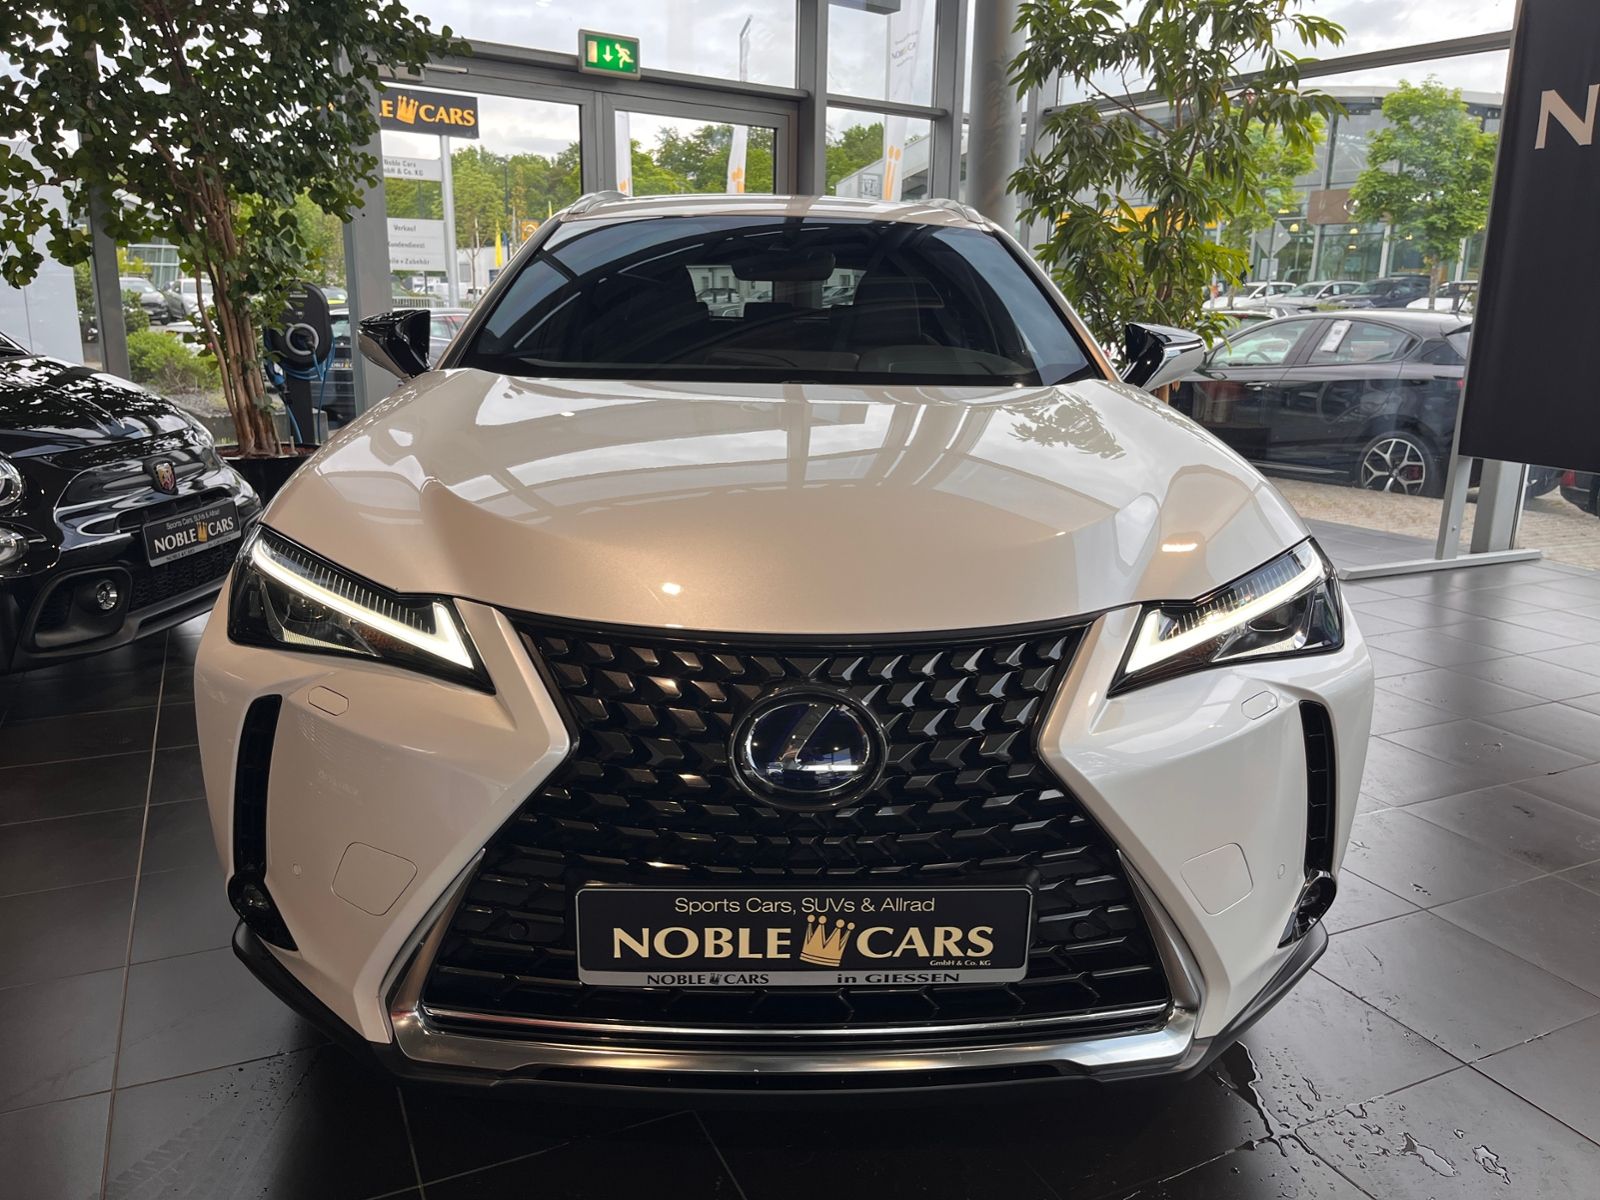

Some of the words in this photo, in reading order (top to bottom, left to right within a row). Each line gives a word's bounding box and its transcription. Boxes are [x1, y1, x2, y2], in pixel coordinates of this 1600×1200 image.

[419, 104, 476, 127] CARS
[1535, 84, 1600, 150] N
[402, 160, 416, 168] Cars
[393, 224, 417, 232] Verkauf
[154, 528, 197, 554] NOBLE
[208, 516, 234, 536] CARS
[674, 897, 741, 915] Sports
[745, 897, 797, 915] Cars,
[801, 897, 856, 913] SUVs
[860, 898, 875, 912] &
[880, 897, 935, 912] Allrad
[612, 926, 792, 959] NOBLE
[856, 926, 994, 959] CARS
[929, 959, 955, 967] GmbH
[979, 959, 991, 967] KG
[647, 974, 706, 985] NOBLE
[724, 974, 769, 985] CARS
[837, 974, 857, 984] in
[865, 973, 960, 984] GIESSEN
